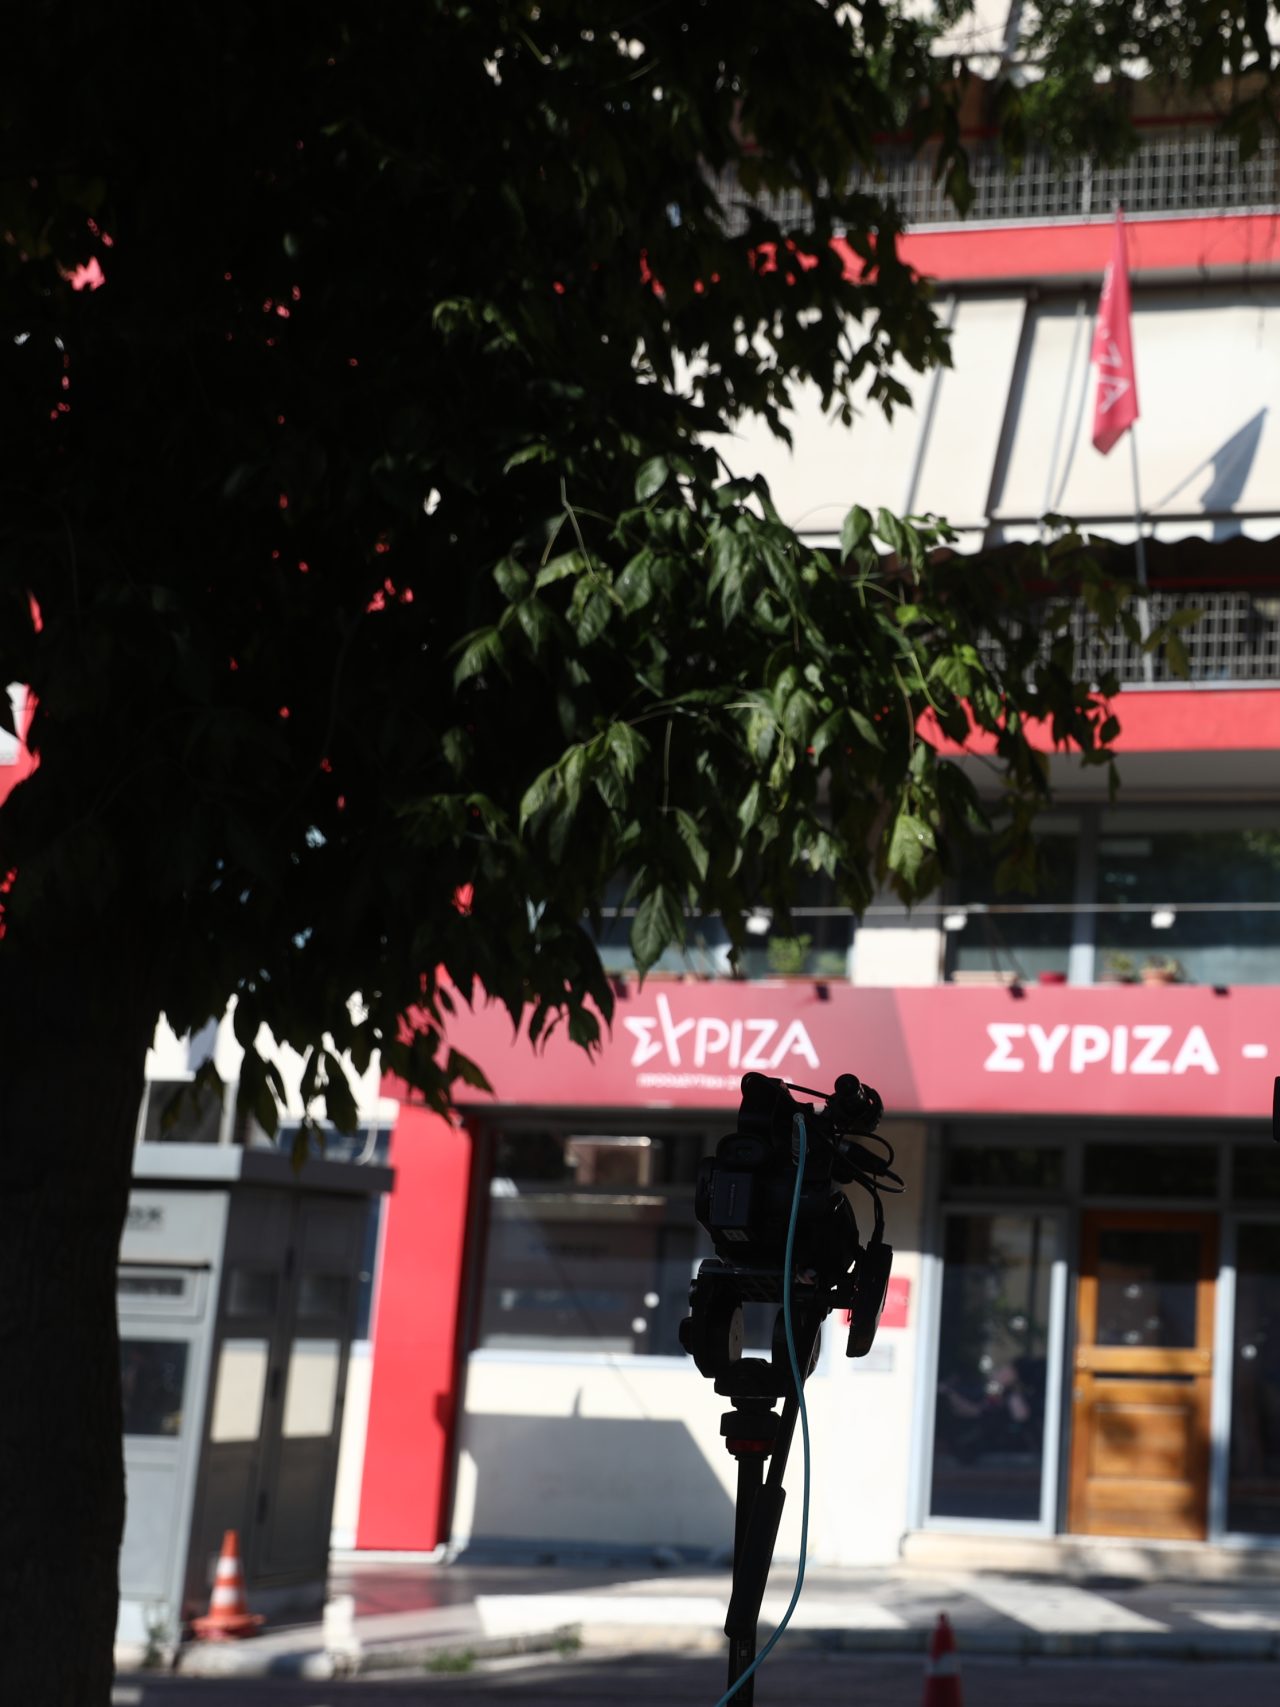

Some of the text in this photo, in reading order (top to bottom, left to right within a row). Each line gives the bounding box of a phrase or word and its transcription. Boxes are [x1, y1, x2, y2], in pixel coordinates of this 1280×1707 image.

[623, 993, 820, 1069] ΣΥΡΙΖΑ
[984, 1022, 1219, 1074] ΣΥΡΙΖΑ
[1241, 1043, 1268, 1058] -
